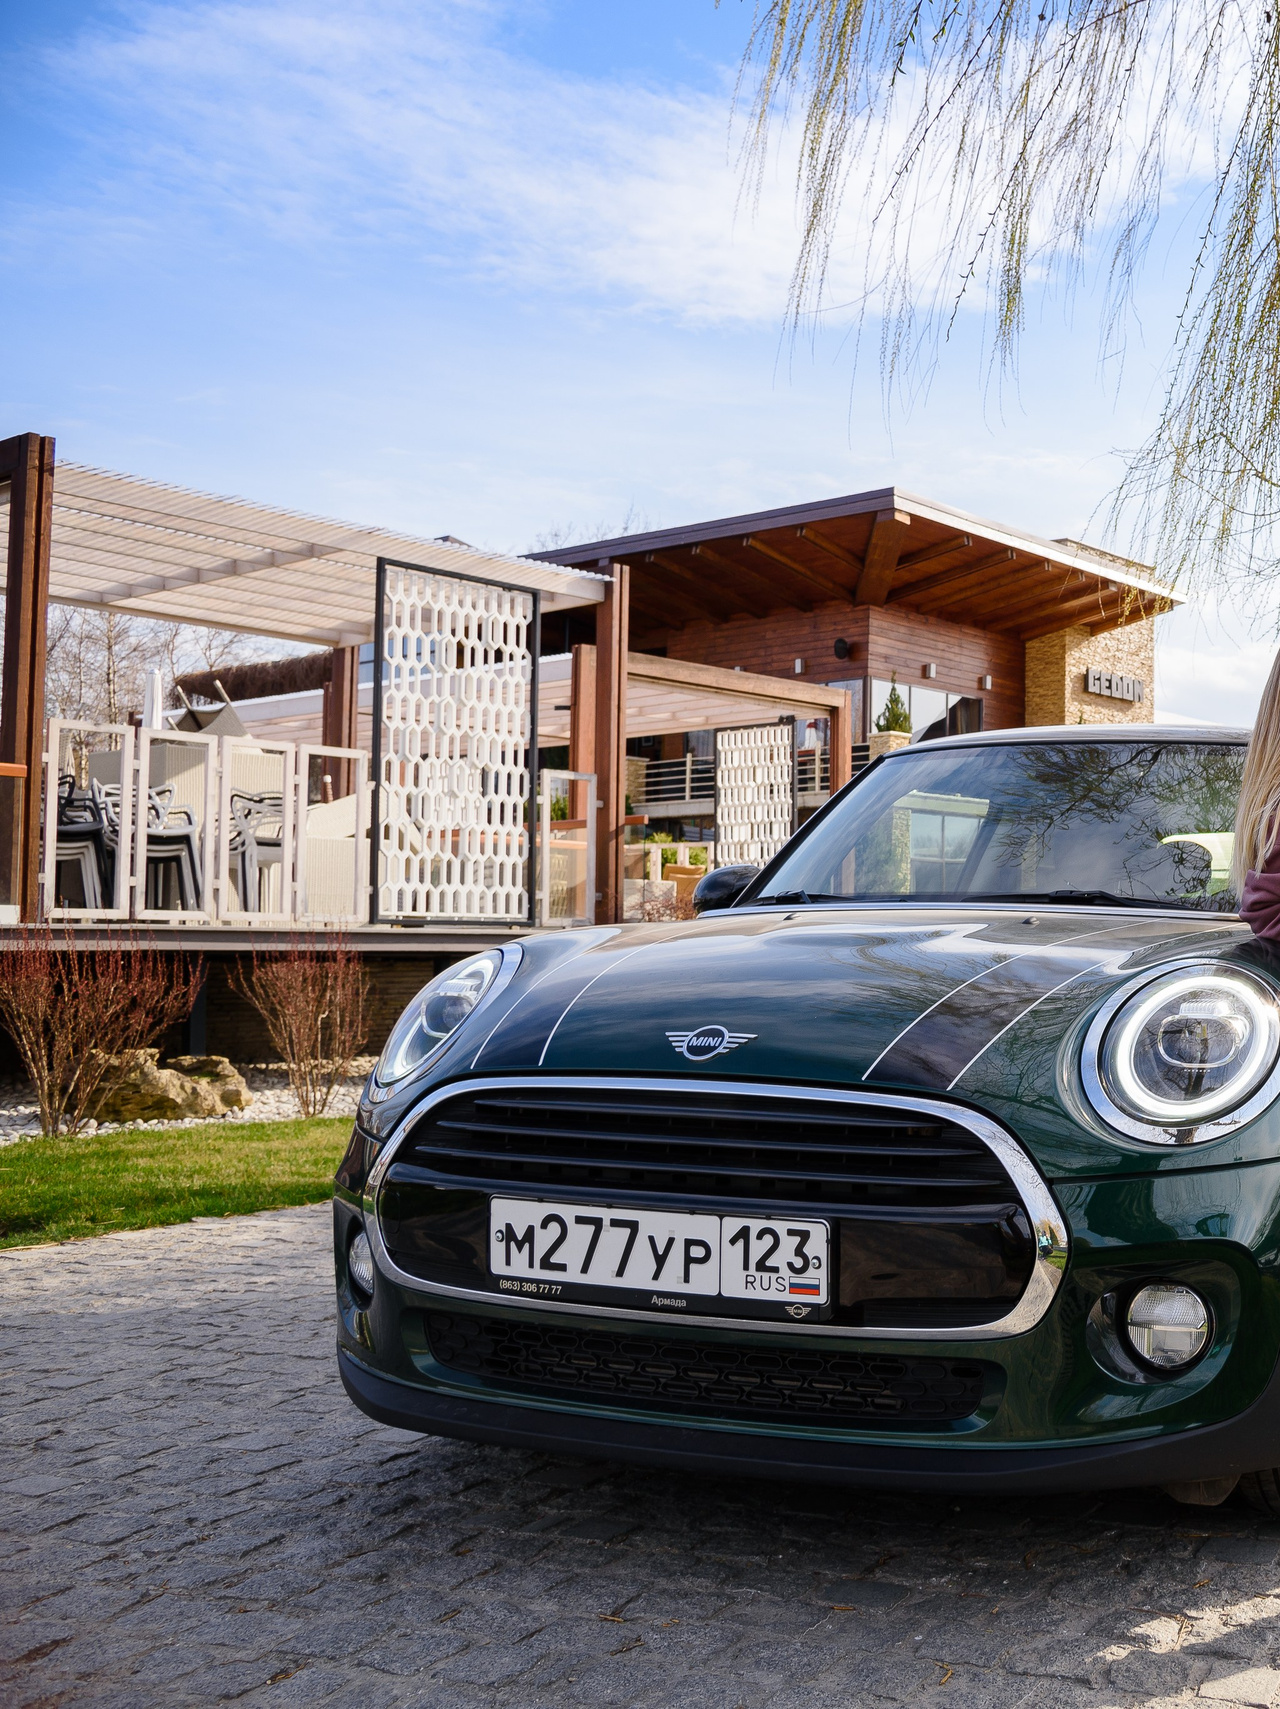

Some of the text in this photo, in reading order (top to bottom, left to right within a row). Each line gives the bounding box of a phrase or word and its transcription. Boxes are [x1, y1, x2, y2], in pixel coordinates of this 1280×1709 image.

[1086, 668, 1144, 702] GEDON
[688, 1036, 722, 1047] MINI
[504, 1212, 811, 1284] М277УР 123
[499, 1279, 562, 1295] (863) 306 77 77
[744, 1274, 787, 1293] RUS
[651, 1295, 687, 1308] Армада
